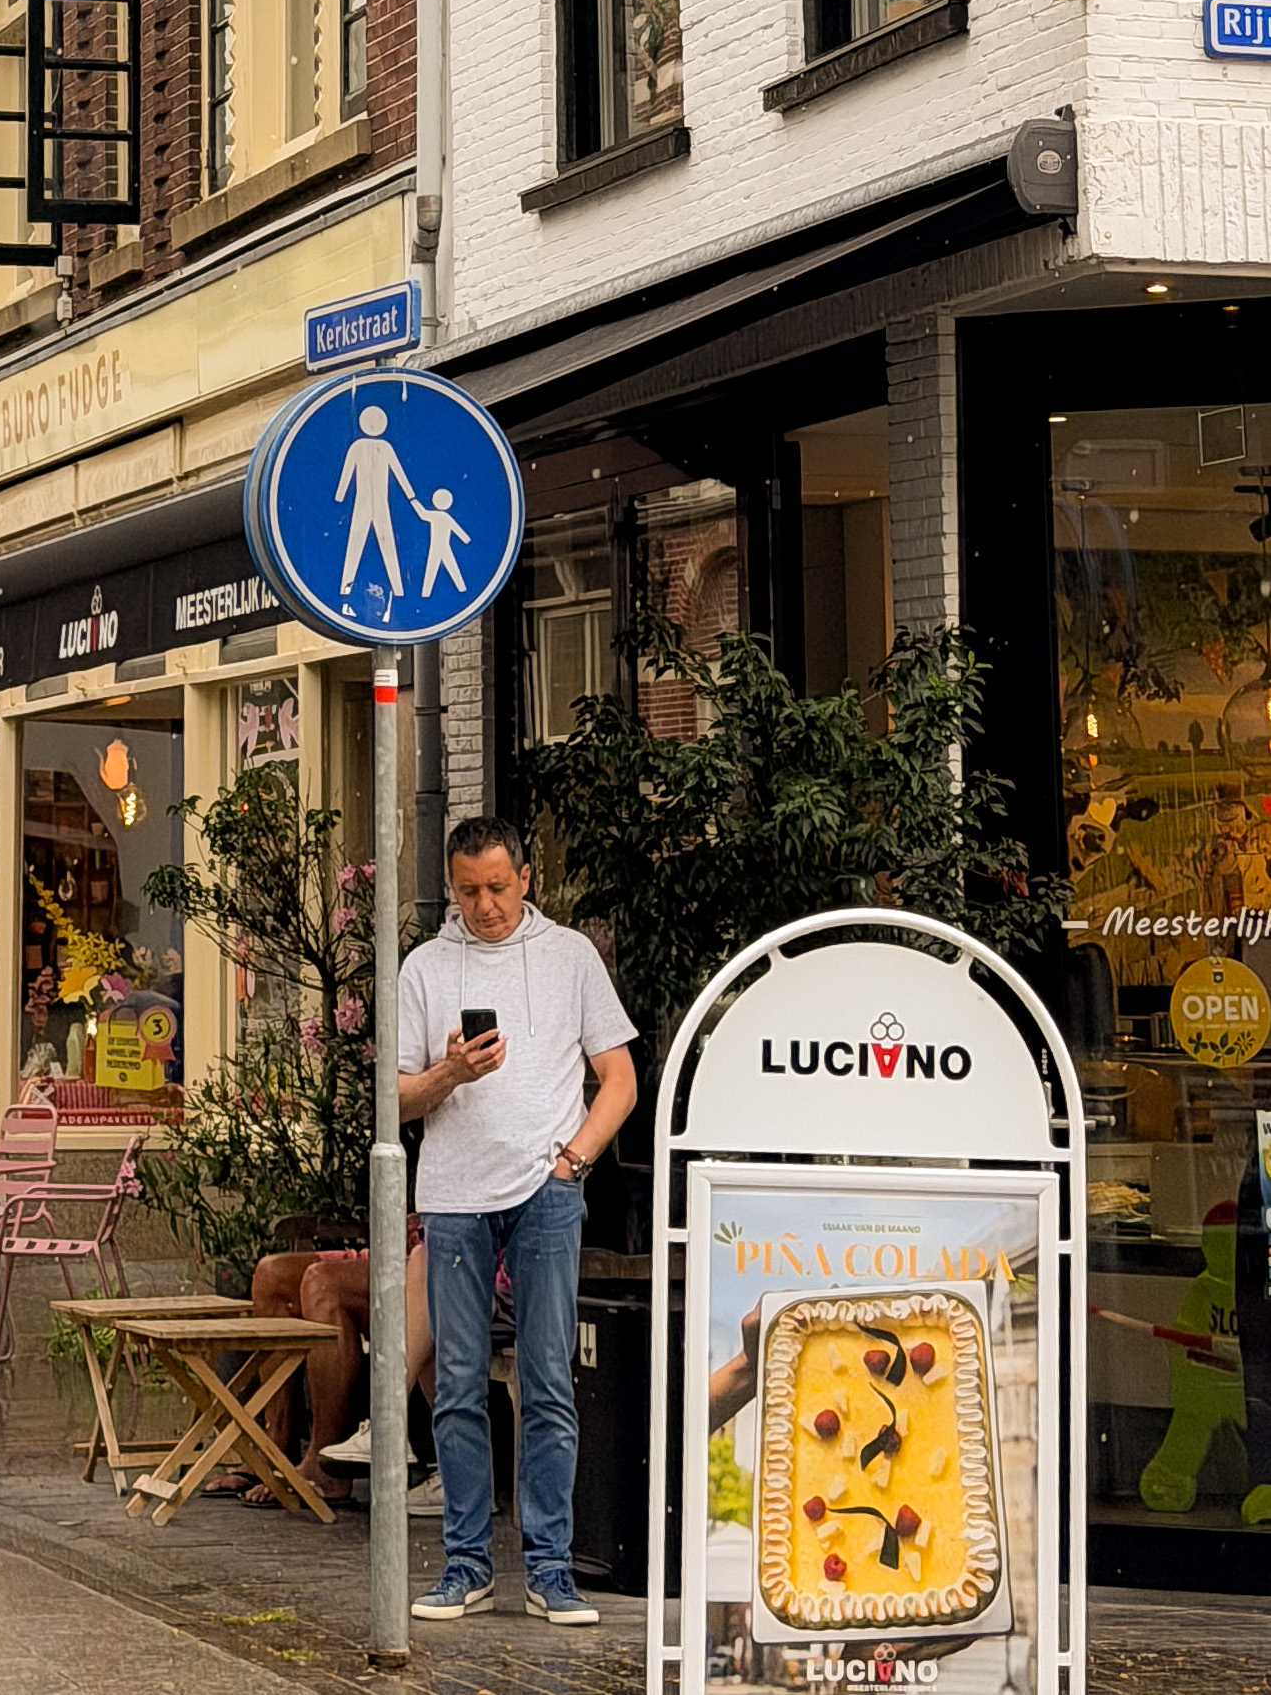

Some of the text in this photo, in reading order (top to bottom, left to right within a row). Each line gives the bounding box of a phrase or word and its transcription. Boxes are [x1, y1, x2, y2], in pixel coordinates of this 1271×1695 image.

[1223, 7, 1271, 45] Rij
[315, 304, 398, 354] Kerkstraat
[1, 349, 123, 450] BURO FUDGE
[175, 575, 260, 632] MEESTERLIJK
[152, 1018, 164, 1036] 3
[1182, 995, 1260, 1022] OPEN
[761, 1038, 972, 1081] LUCIANO
[854, 1223, 873, 1233] VAN
[874, 1224, 886, 1233] DE
[888, 1225, 921, 1234] MAAND
[734, 1231, 1017, 1282] PIÑA COLADA
[1210, 1302, 1240, 1335] SLO
[806, 1659, 939, 1683] LUCIANO
